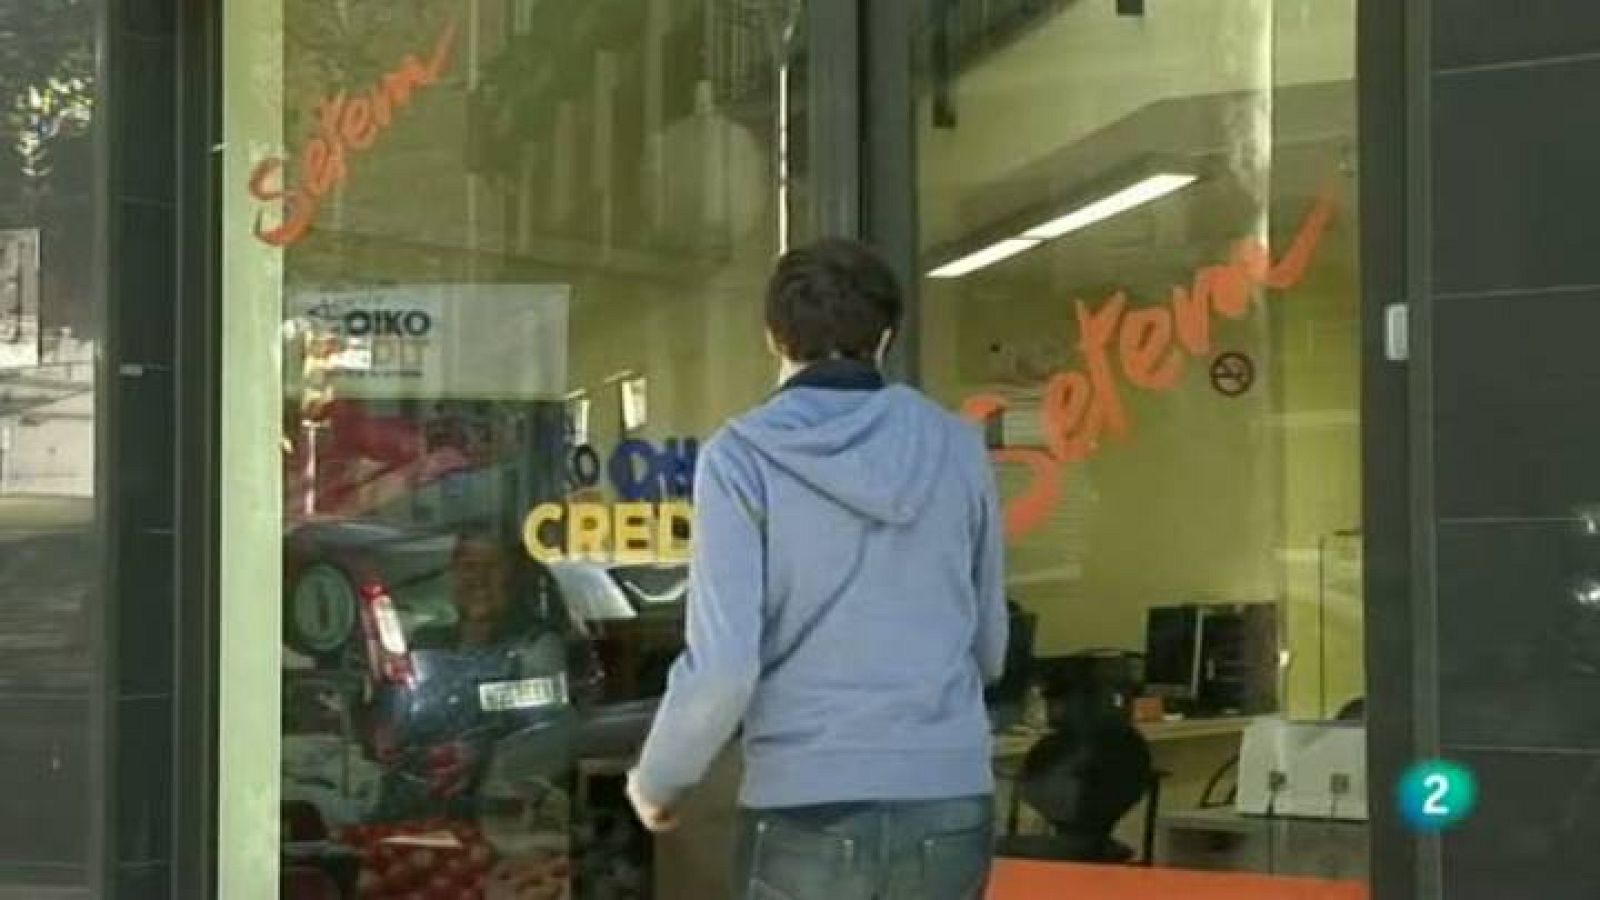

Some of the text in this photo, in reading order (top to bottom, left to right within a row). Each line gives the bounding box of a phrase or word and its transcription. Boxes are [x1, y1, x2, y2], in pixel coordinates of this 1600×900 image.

[249, 22, 458, 247] Setem
[345, 310, 432, 337] OIKO
[962, 180, 1340, 543] Setem
